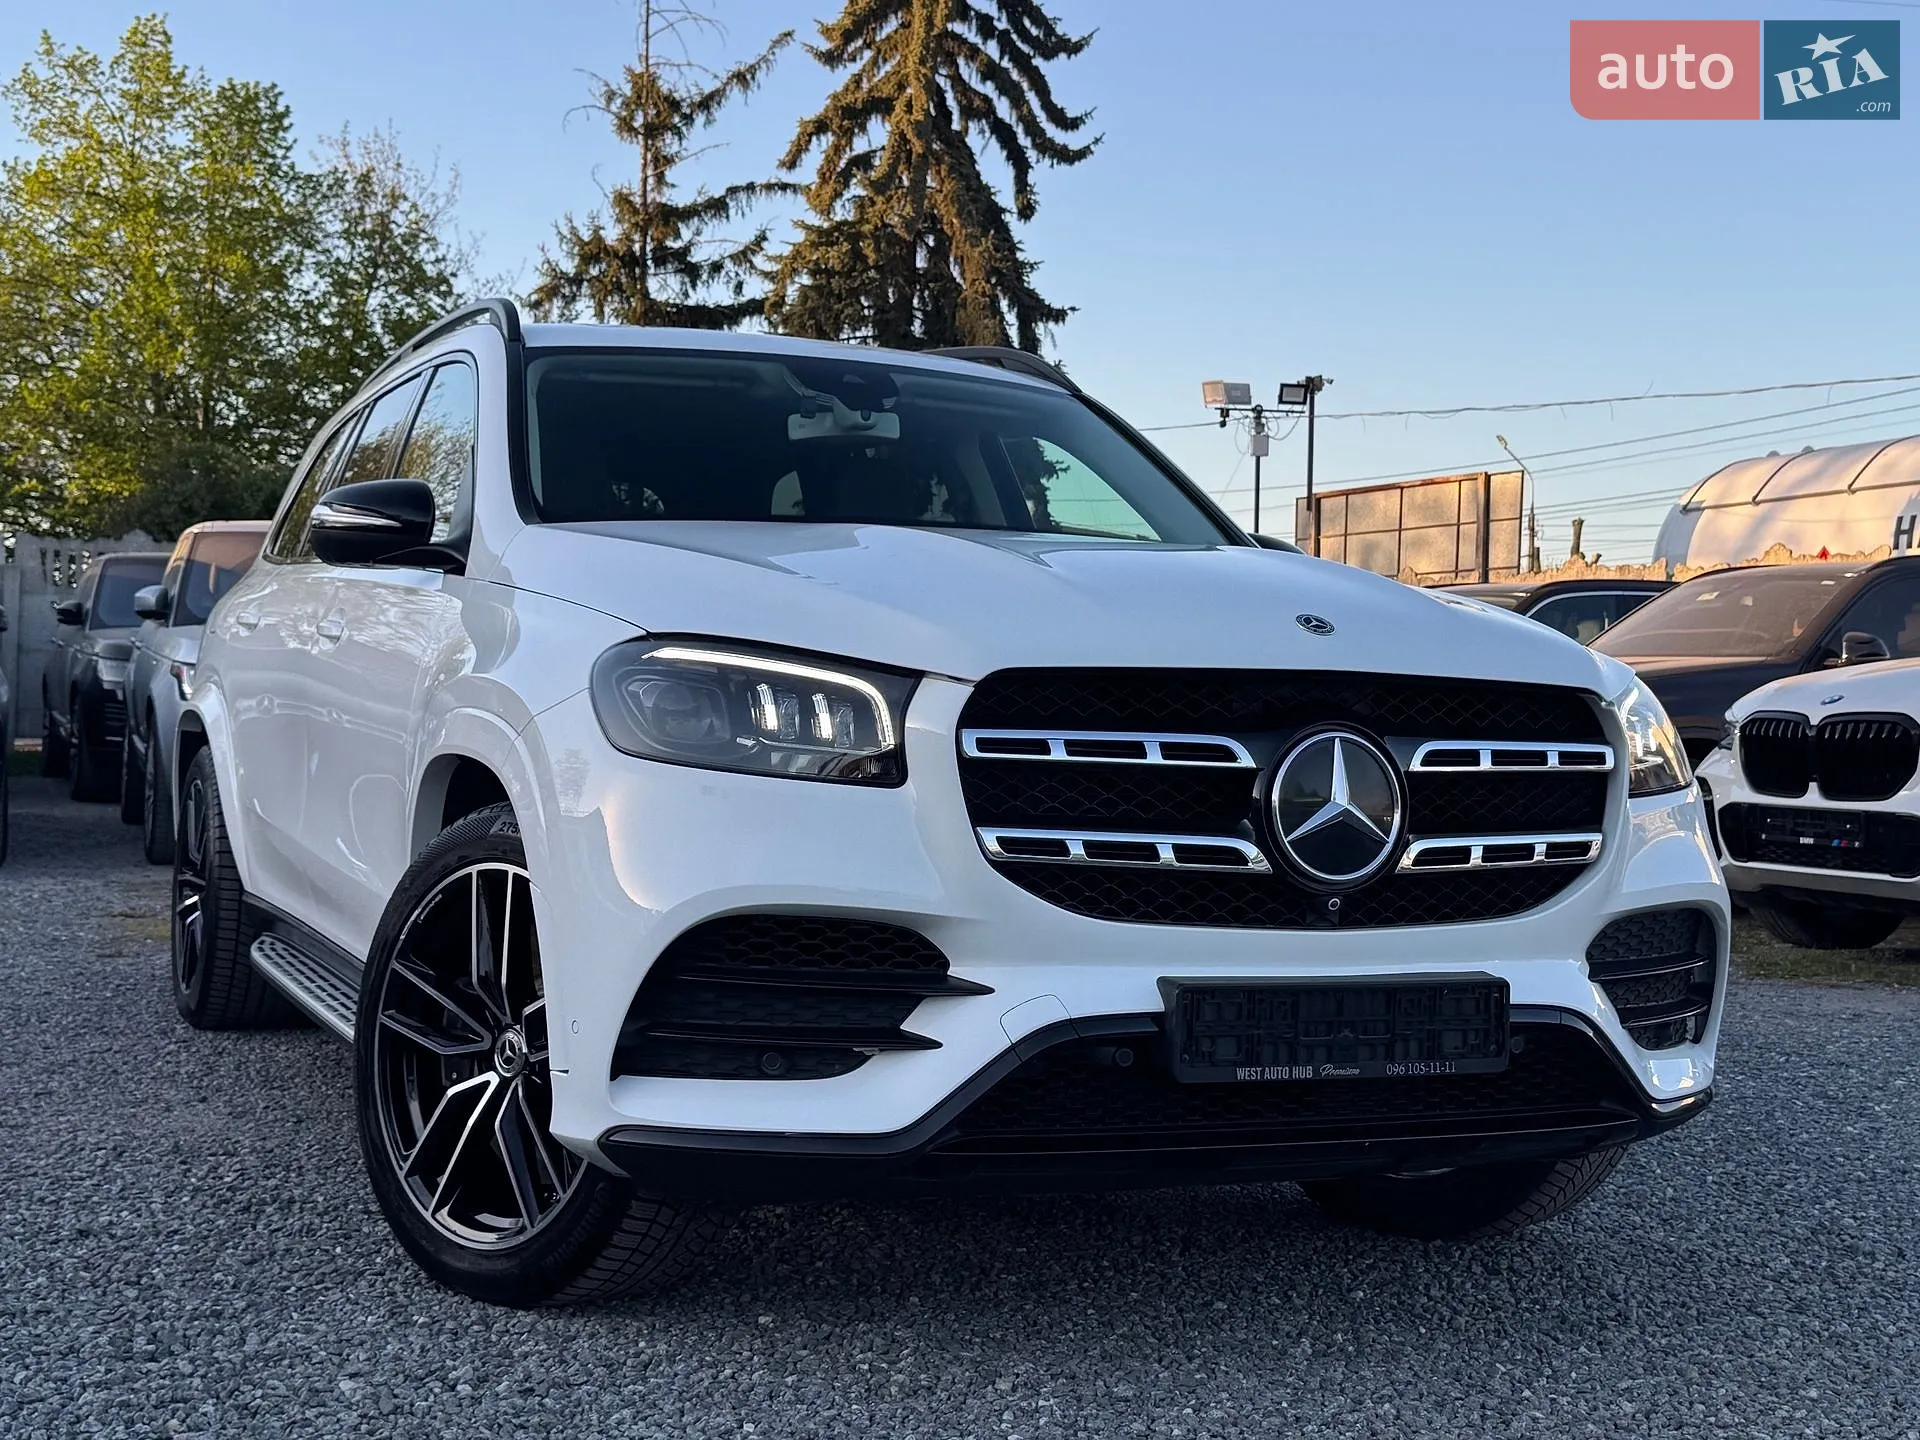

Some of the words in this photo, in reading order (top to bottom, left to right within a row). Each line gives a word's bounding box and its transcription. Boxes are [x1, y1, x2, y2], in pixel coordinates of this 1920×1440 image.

[1236, 1067, 1262, 1080] WEST
[1264, 1066, 1290, 1080] AUTO
[1292, 1065, 1313, 1079] HUB
[1386, 1063, 1405, 1076] 096
[1407, 1061, 1456, 1074] 105-11-11
